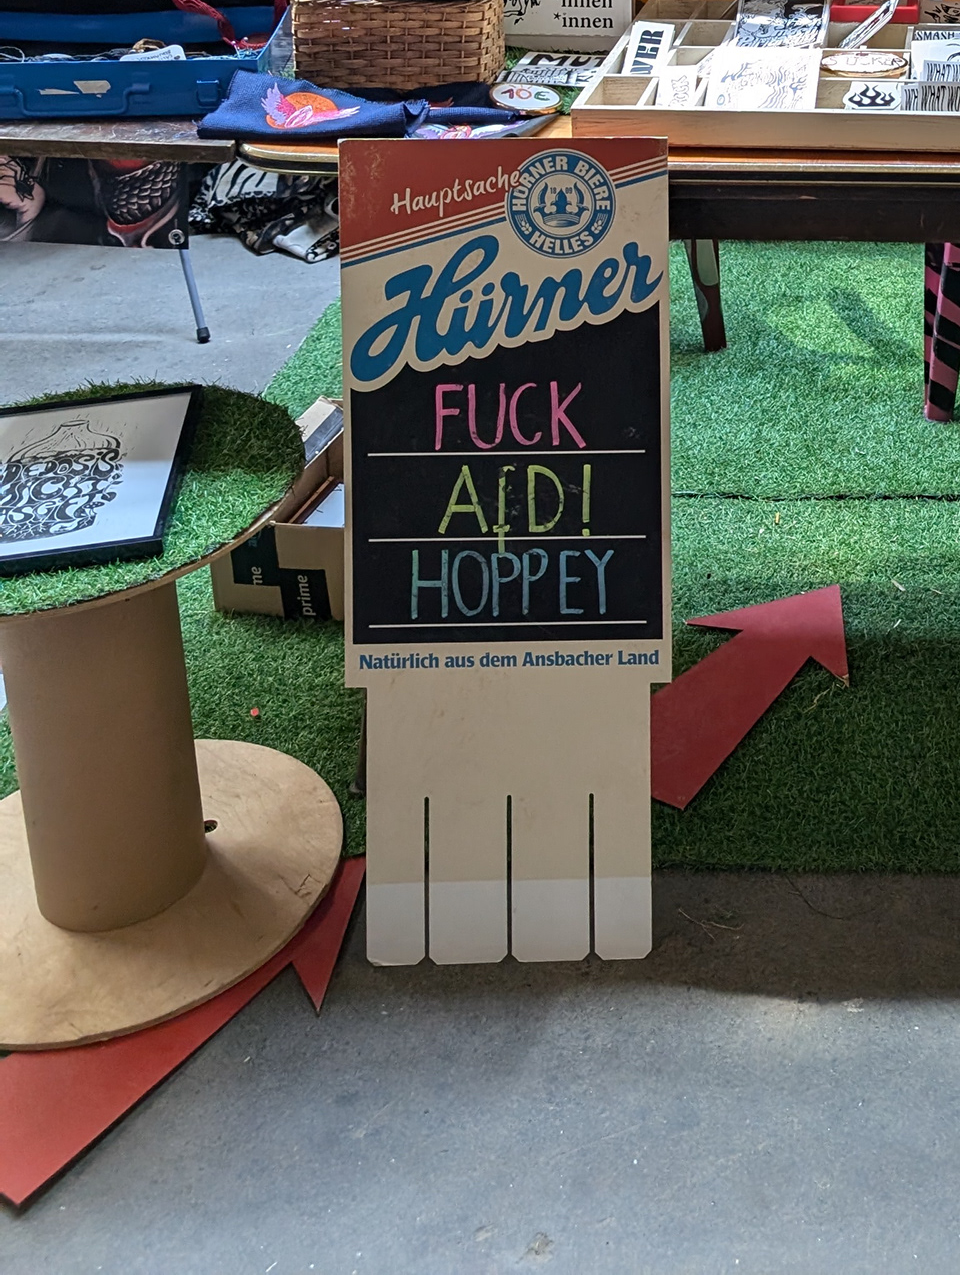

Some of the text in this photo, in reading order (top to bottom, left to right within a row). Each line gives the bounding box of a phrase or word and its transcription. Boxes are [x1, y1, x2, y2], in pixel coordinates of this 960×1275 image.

[916, 31, 955, 40] SMASH
[390, 166, 520, 215] Hauptsache
[574, 160, 611, 211] BIERE
[529, 231, 594, 254] HELLES
[351, 235, 664, 382] Hürner
[434, 381, 586, 450] FUCK
[297, 574, 316, 616] prime
[411, 548, 615, 620] HOPPEY
[359, 649, 660, 670] Natürlich aus dem Ansbacher Land
